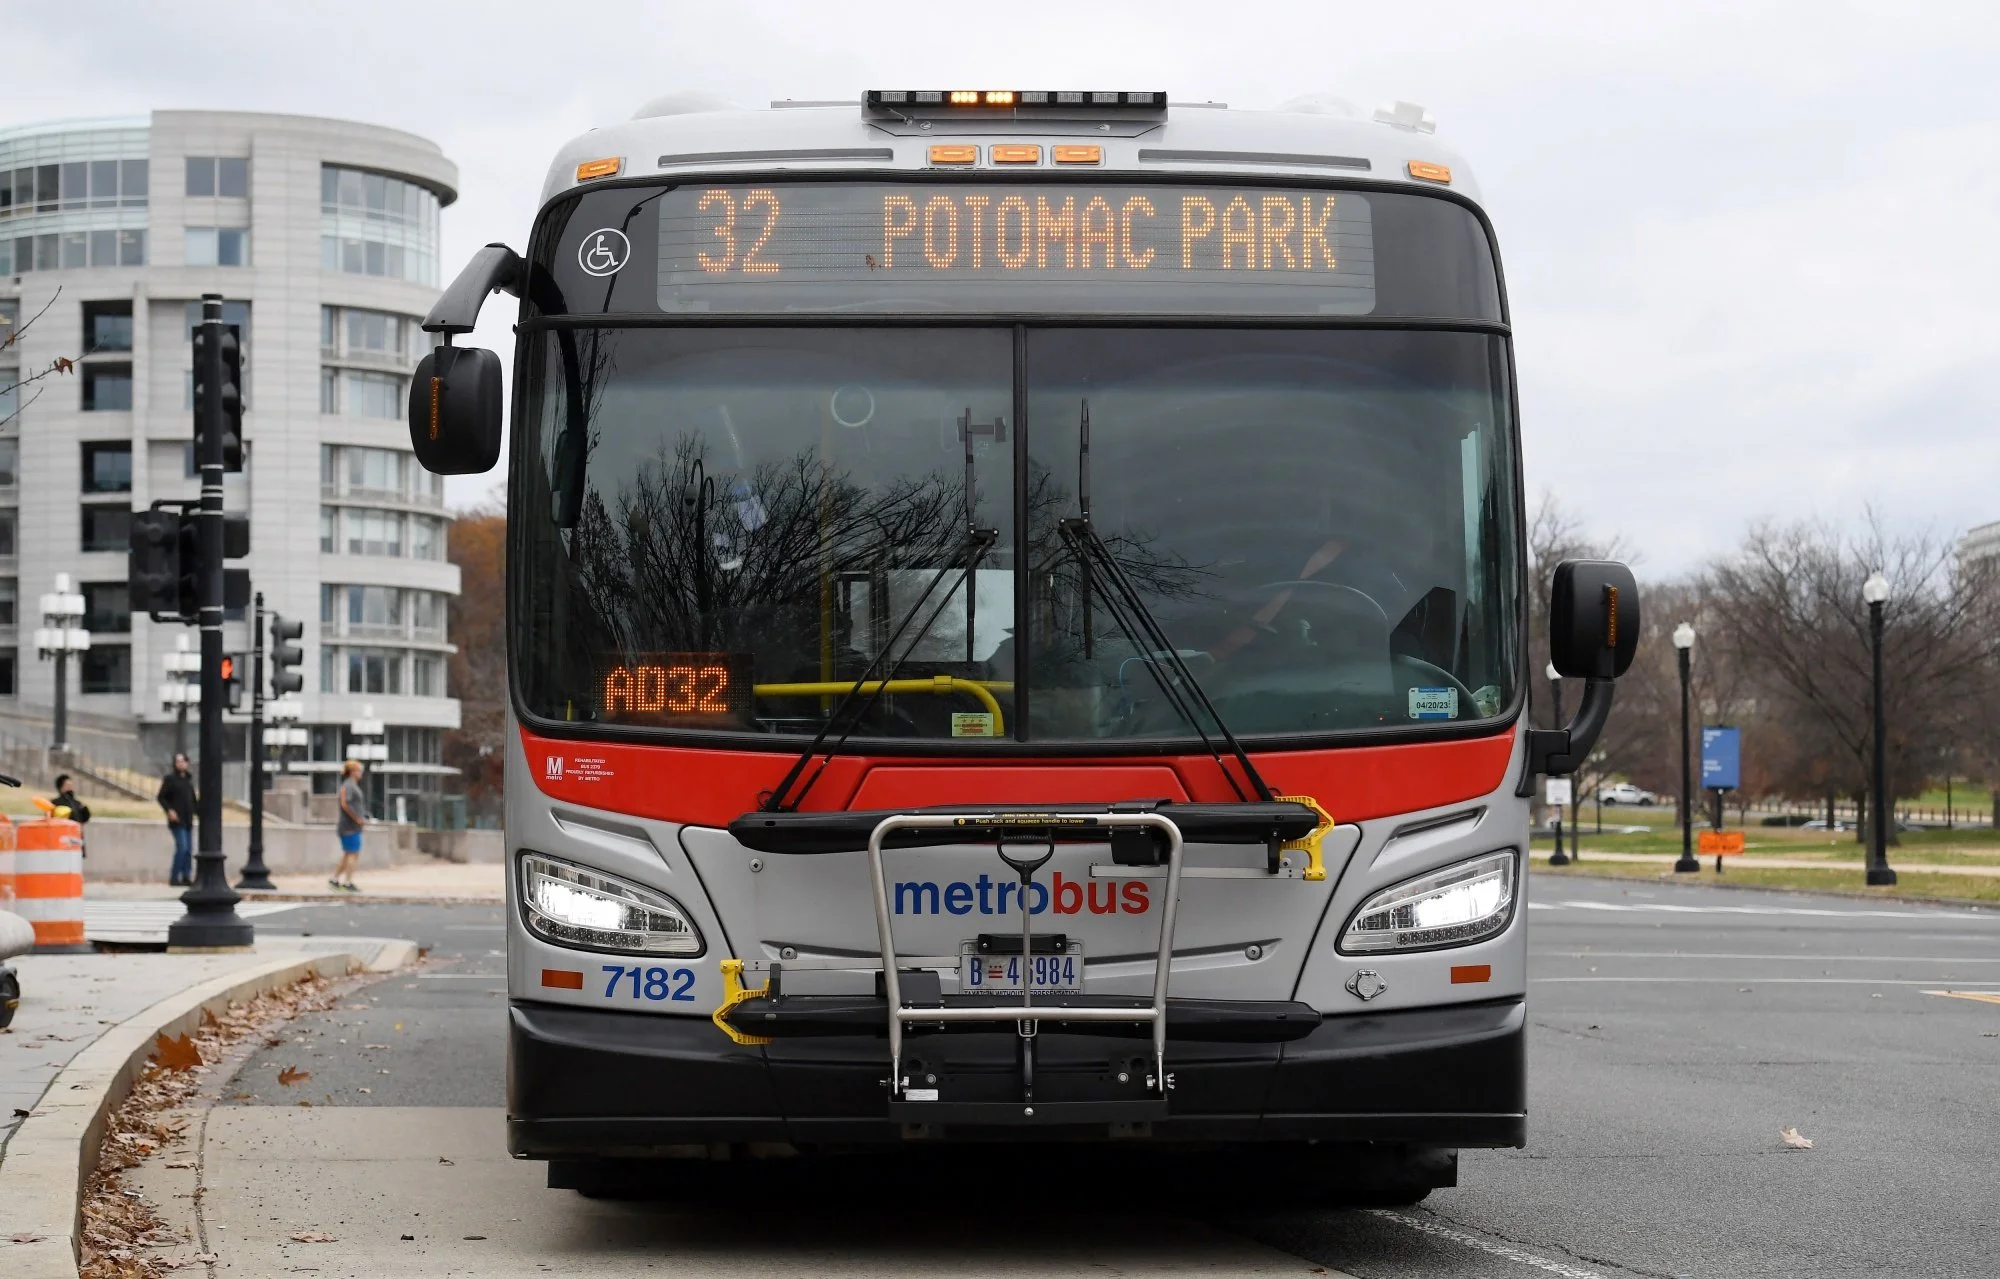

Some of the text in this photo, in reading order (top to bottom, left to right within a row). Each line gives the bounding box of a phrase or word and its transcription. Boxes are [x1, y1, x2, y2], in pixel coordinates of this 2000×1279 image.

[698, 188, 1336, 273] 32 POTOMAC PARK
[1416, 701, 1449, 709] 04/20/23
[548, 756, 563, 775] M
[894, 871, 1150, 915] metrobus
[602, 966, 696, 1001] 7182
[970, 957, 983, 986] B
